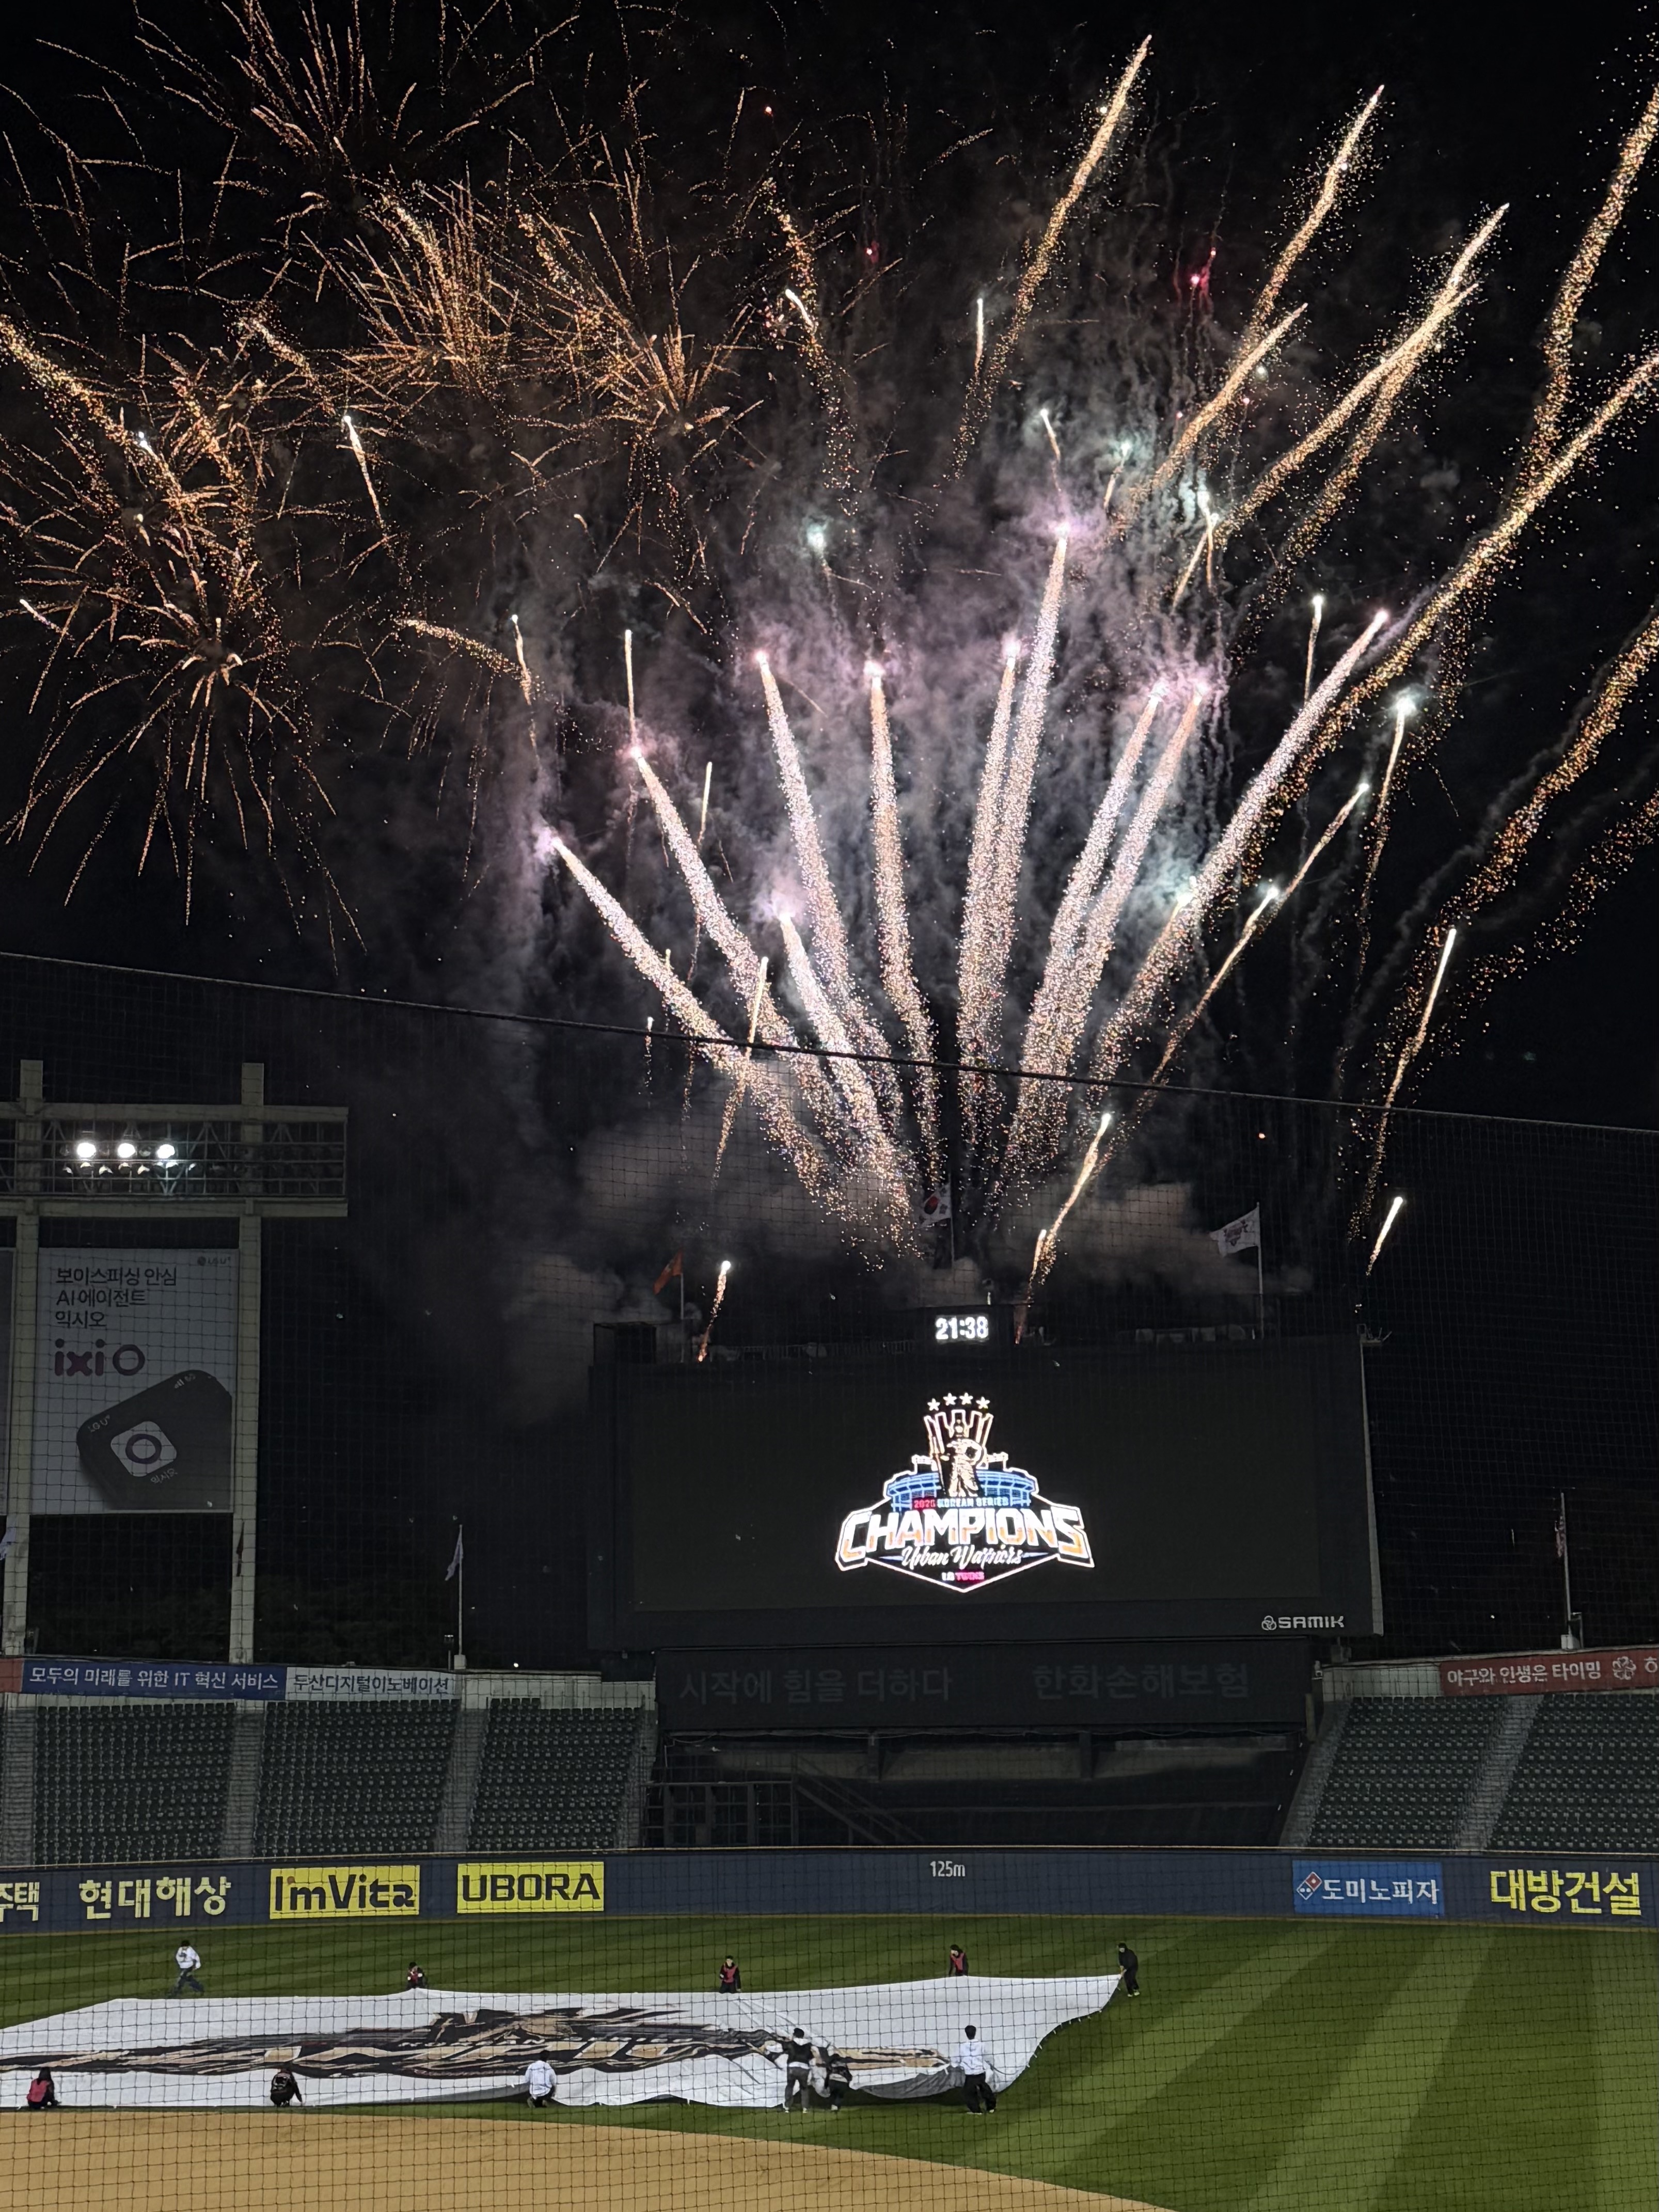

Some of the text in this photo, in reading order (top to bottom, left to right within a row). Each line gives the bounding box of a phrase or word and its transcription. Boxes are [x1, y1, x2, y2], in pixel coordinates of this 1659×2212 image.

[55, 1267, 177, 1286] 보이스피싱 안심
[56, 1289, 148, 1307] AI 에이전트
[55, 1310, 107, 1329] 익시오
[936, 1316, 989, 1340] 21:38
[937, 1498, 974, 1508] KOREAN
[976, 1496, 1009, 1506] SERIES
[838, 1506, 1092, 1562] CHAMPIONS
[902, 1544, 1022, 1570] Urban Warriors
[955, 1571, 985, 1581] TWINS
[1278, 1616, 1345, 1629] SAMIK
[29, 1667, 278, 1690] 모두의 미래를 위한 IT 혁신 서비스
[294, 1674, 448, 1695] 두산디지털이노베이션
[679, 1667, 953, 1704] 시작에 힘을 더하다
[1032, 1664, 1250, 1699] 한화손해보험
[1447, 1661, 1601, 1686] 야구와 인생은 타이밍
[930, 1860, 966, 1877] 125m
[78, 1876, 232, 1920] 현대해상
[462, 1873, 601, 1902] UBORA
[1322, 1878, 1440, 1905] 도미노피자
[1490, 1869, 1641, 1916] 대방건설
